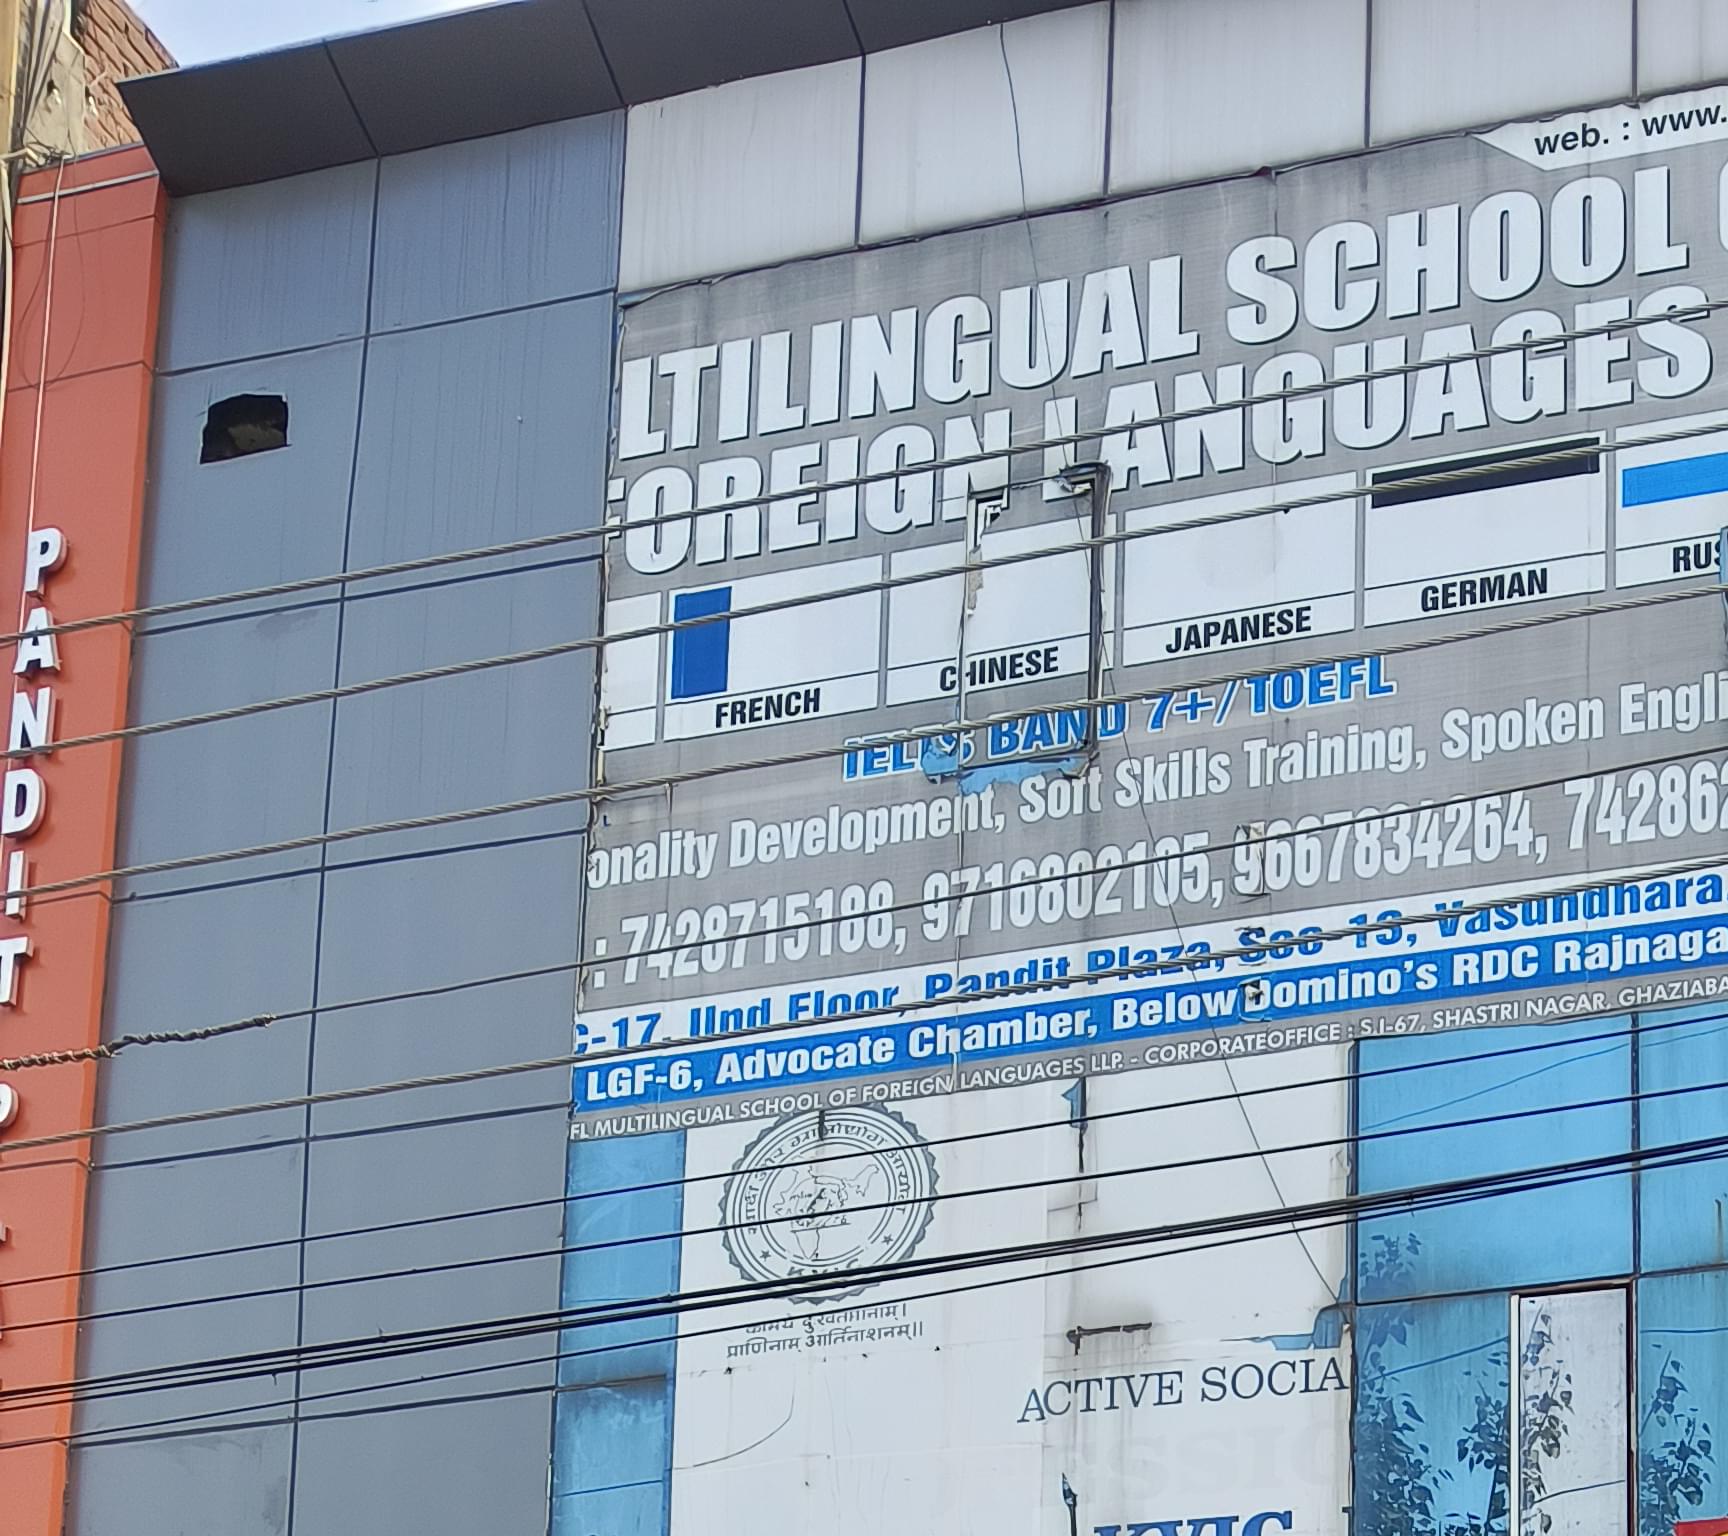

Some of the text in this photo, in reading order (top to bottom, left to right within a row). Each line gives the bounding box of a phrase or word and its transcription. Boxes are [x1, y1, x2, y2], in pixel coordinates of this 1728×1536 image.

[619, 255, 1199, 460] LTILINGUAL
[1226, 165, 1690, 345] SCHOOL
[1042, 285, 1712, 500] LANGUAGES
[1165, 607, 1313, 654] JAPANESE
[1420, 567, 1549, 613] GERMAN
[714, 687, 821, 729] FRENCH
[938, 647, 1059, 688] CHINESE
[729, 787, 1005, 868] Development,
[1113, 746, 1232, 810] Skills
[1243, 720, 1427, 790] Training,
[1439, 697, 1603, 761] Spoken
[586, 1055, 704, 1102] LGF-6,
[716, 1034, 895, 1088] Advocate
[908, 1006, 1098, 1063] Chamber,
[1111, 984, 1237, 1031] Below
[1453, 945, 1540, 988] RDC
[596, 1105, 737, 1139] MULTILINGUAL
[739, 1093, 824, 1122] SCHOOL
[959, 1058, 1085, 1091] LANGUAGES
[1145, 1022, 1341, 1066] CORPORATEOFFICE
[1432, 1000, 1520, 1030] SHASTRI
[1016, 1356, 1350, 1424] ACTIVE SOCIA
